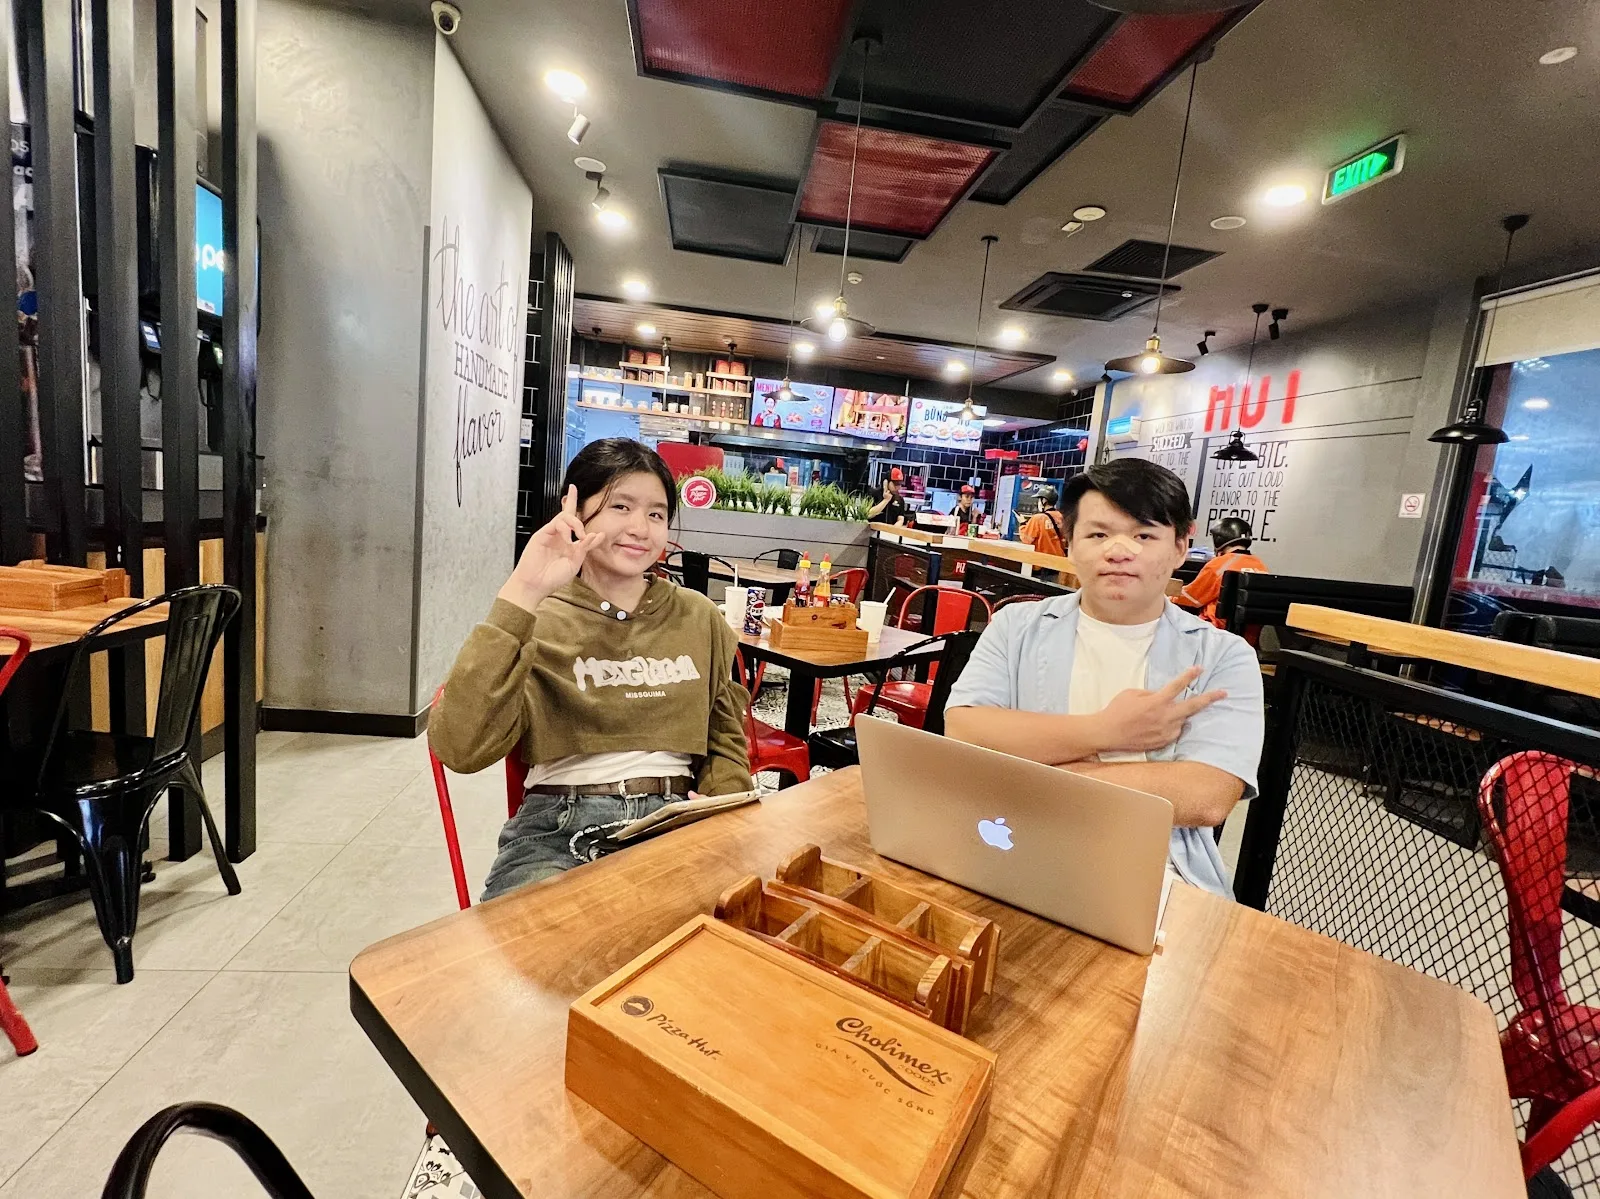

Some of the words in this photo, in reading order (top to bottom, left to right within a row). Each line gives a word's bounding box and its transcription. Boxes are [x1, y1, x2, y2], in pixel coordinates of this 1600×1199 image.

[1332, 153, 1374, 195] EXIT
[433, 215, 475, 340] the
[479, 260, 509, 350] art
[506, 272, 523, 403] of
[454, 341, 509, 400] HANDMADE
[453, 384, 506, 508] flavor
[1166, 452, 1175, 467] TO
[1178, 451, 1191, 466] THE
[1257, 441, 1288, 468] BIG.
[1213, 472, 1235, 488] LIVE
[1239, 472, 1256, 488] OUT
[1210, 490, 1242, 506] FLAVOR
[1247, 490, 1258, 506] TO
[1263, 490, 1281, 507] THE
[625, 690, 667, 699] MISSGUIMA
[646, 1013, 690, 1040] Pizza
[815, 1042, 838, 1054] GIA
